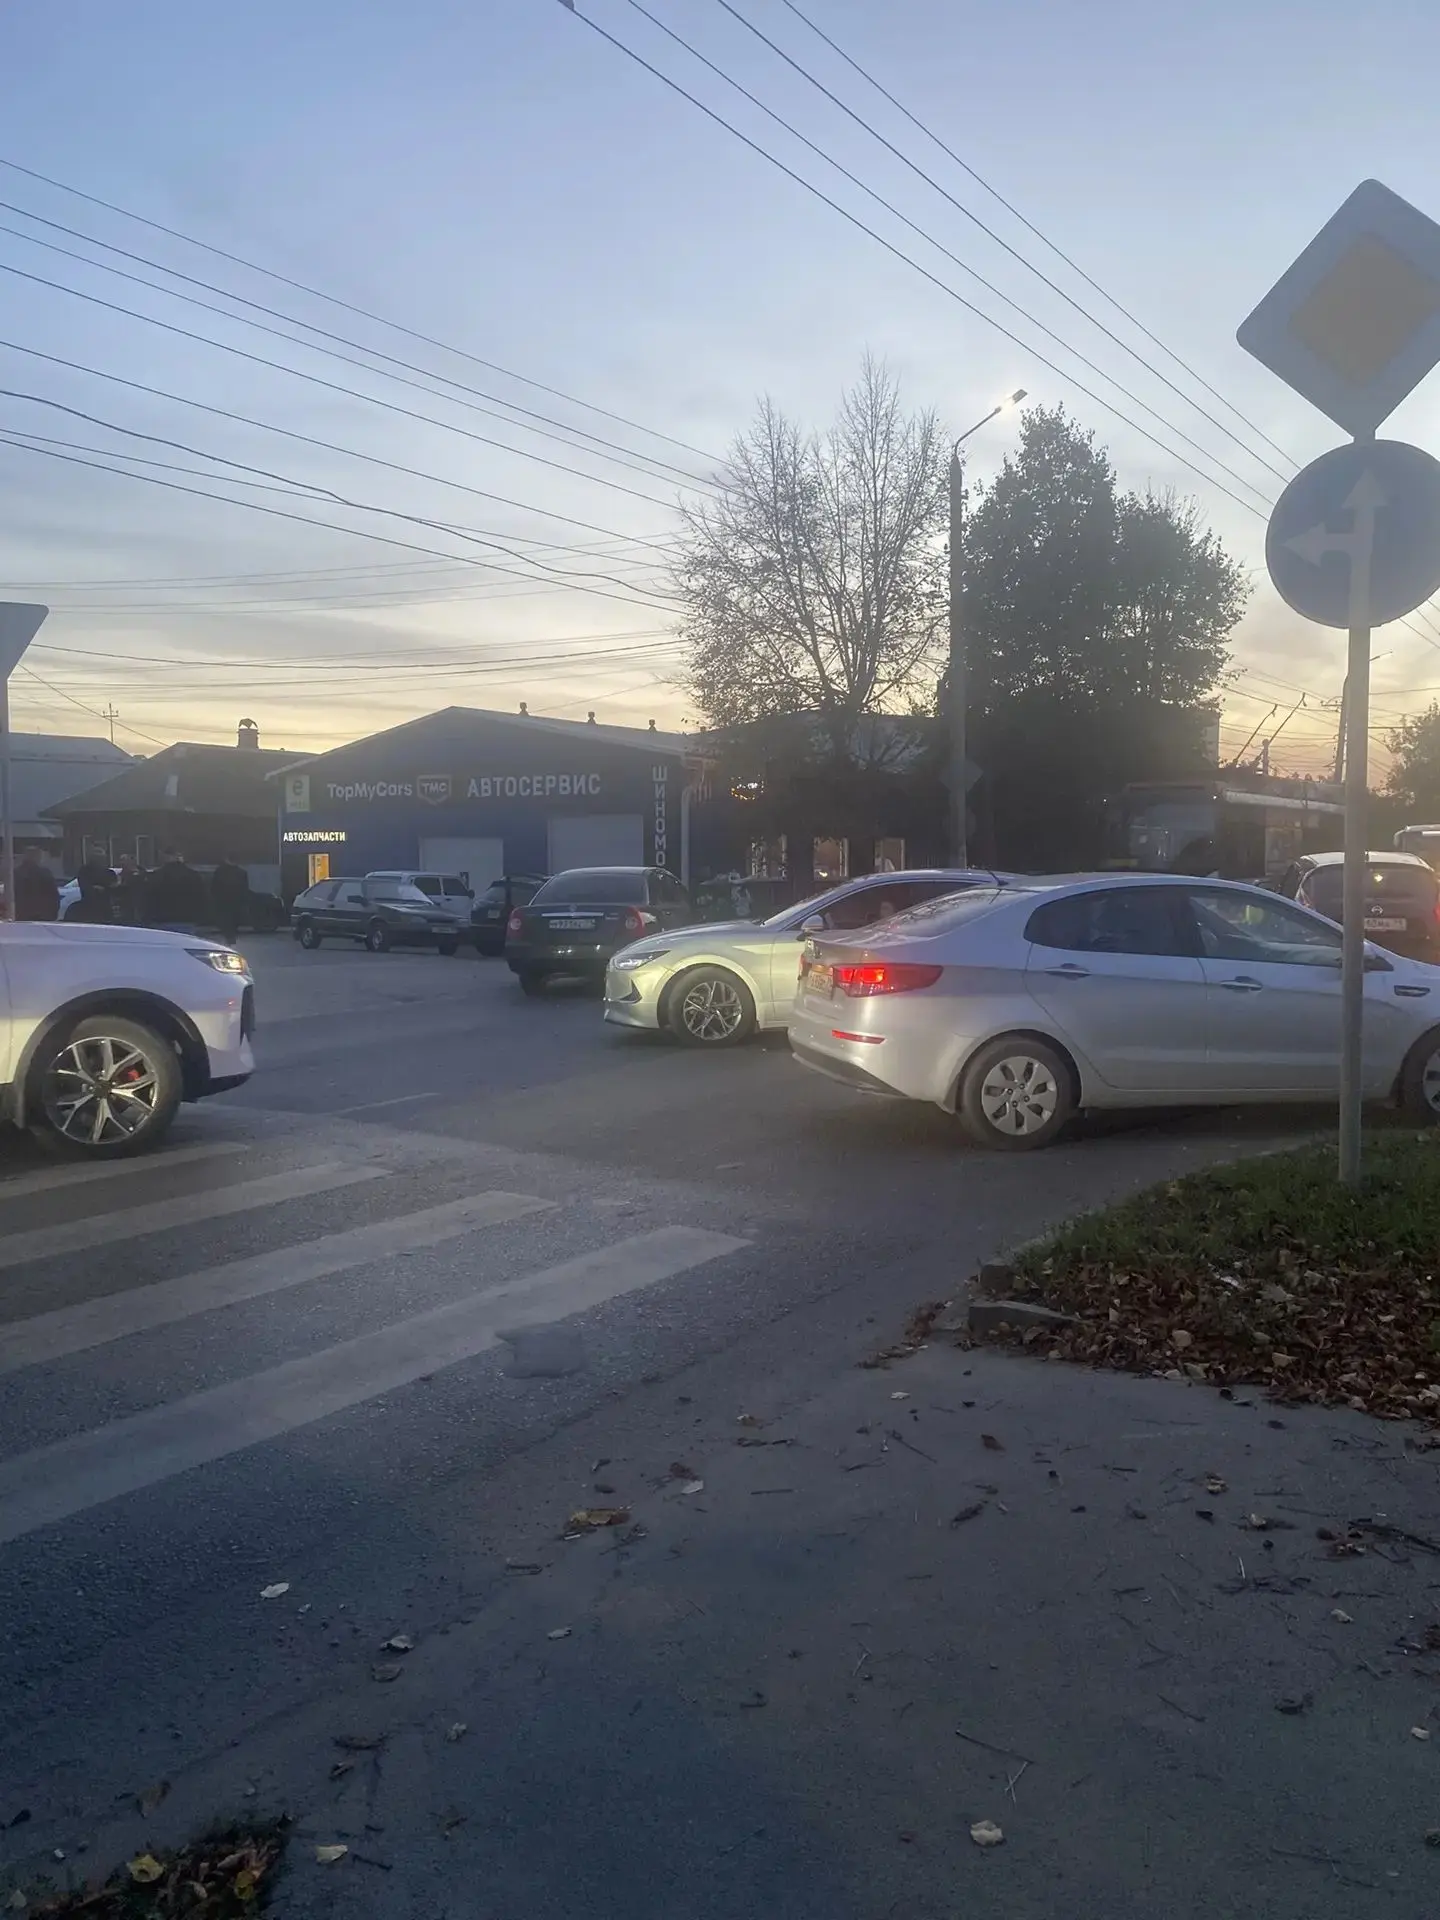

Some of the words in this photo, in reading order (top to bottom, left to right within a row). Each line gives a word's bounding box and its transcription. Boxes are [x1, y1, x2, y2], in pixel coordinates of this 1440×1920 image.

[327, 781, 413, 802] TopMyCars
[421, 781, 447, 795] TMC
[467, 773, 601, 797] АВТОСЕРВИС
[283, 831, 346, 842] АВТОЗАПЧАСТИ
